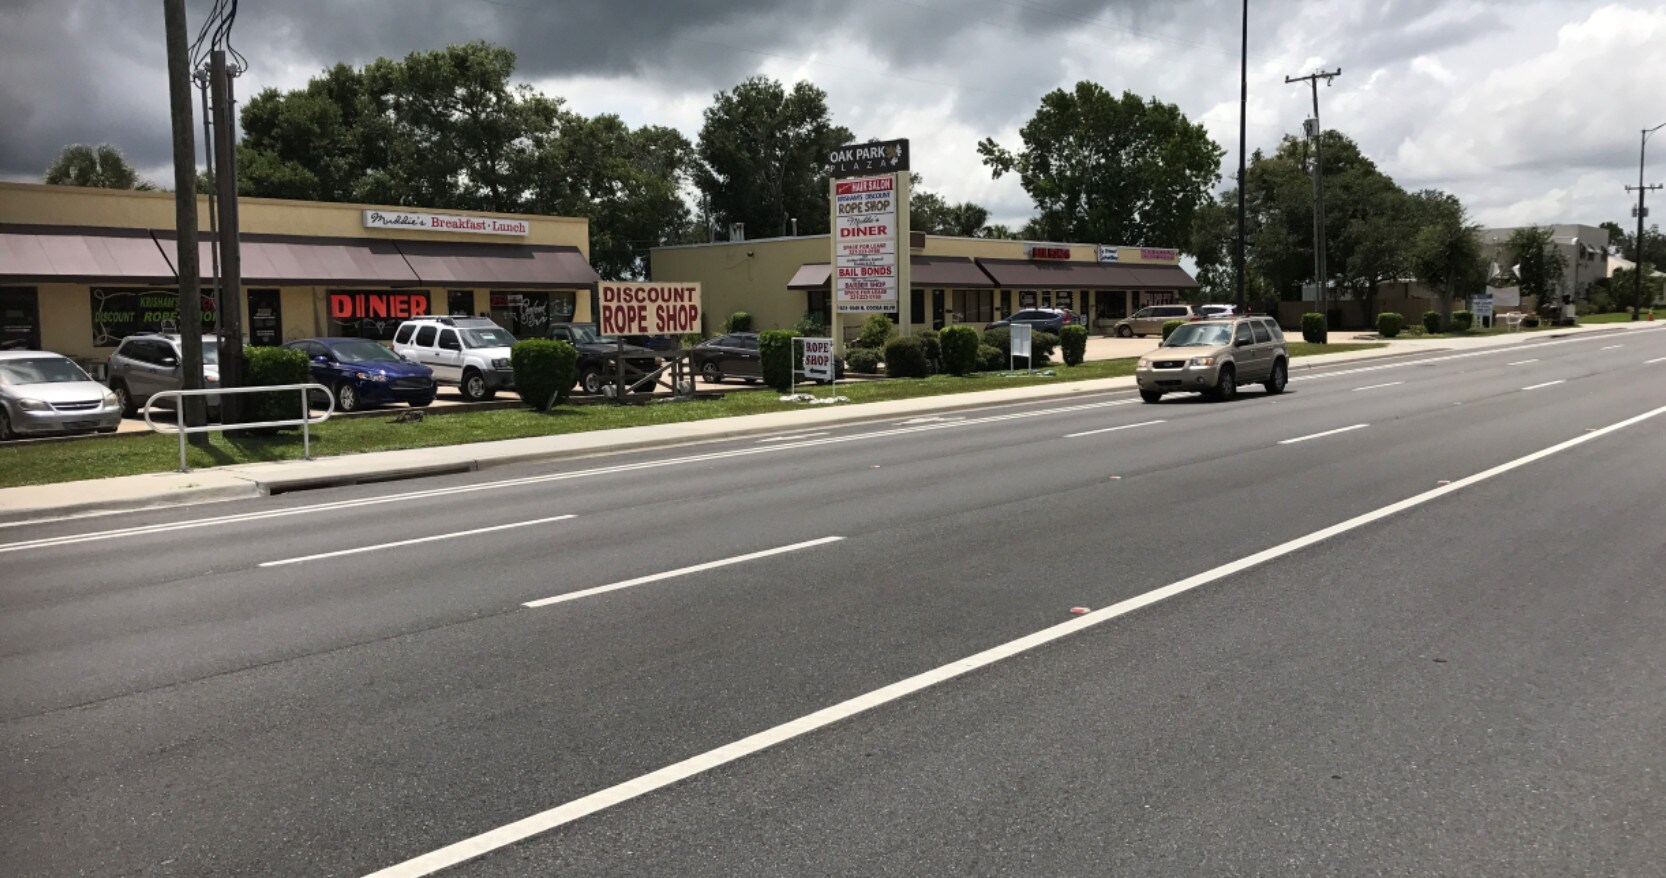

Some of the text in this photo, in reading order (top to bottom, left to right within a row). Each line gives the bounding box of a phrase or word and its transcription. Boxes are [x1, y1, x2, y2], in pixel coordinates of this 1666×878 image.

[830, 146, 885, 163] OAK PARK
[830, 160, 886, 172] PLAZA
[868, 179, 890, 189] SALON
[838, 200, 890, 214] ROPE SHOP
[431, 217, 486, 231] Breakfast
[492, 221, 526, 233] Lunch
[840, 225, 887, 237] DINER
[838, 266, 892, 277] BAIL BONDS
[602, 286, 697, 303] DISCOUNT
[330, 294, 427, 318] DINER
[95, 311, 135, 323] DISCOUNT
[602, 304, 698, 334] ROPE SHOP
[805, 342, 829, 353] ROPE
[805, 354, 829, 366] SHOP
